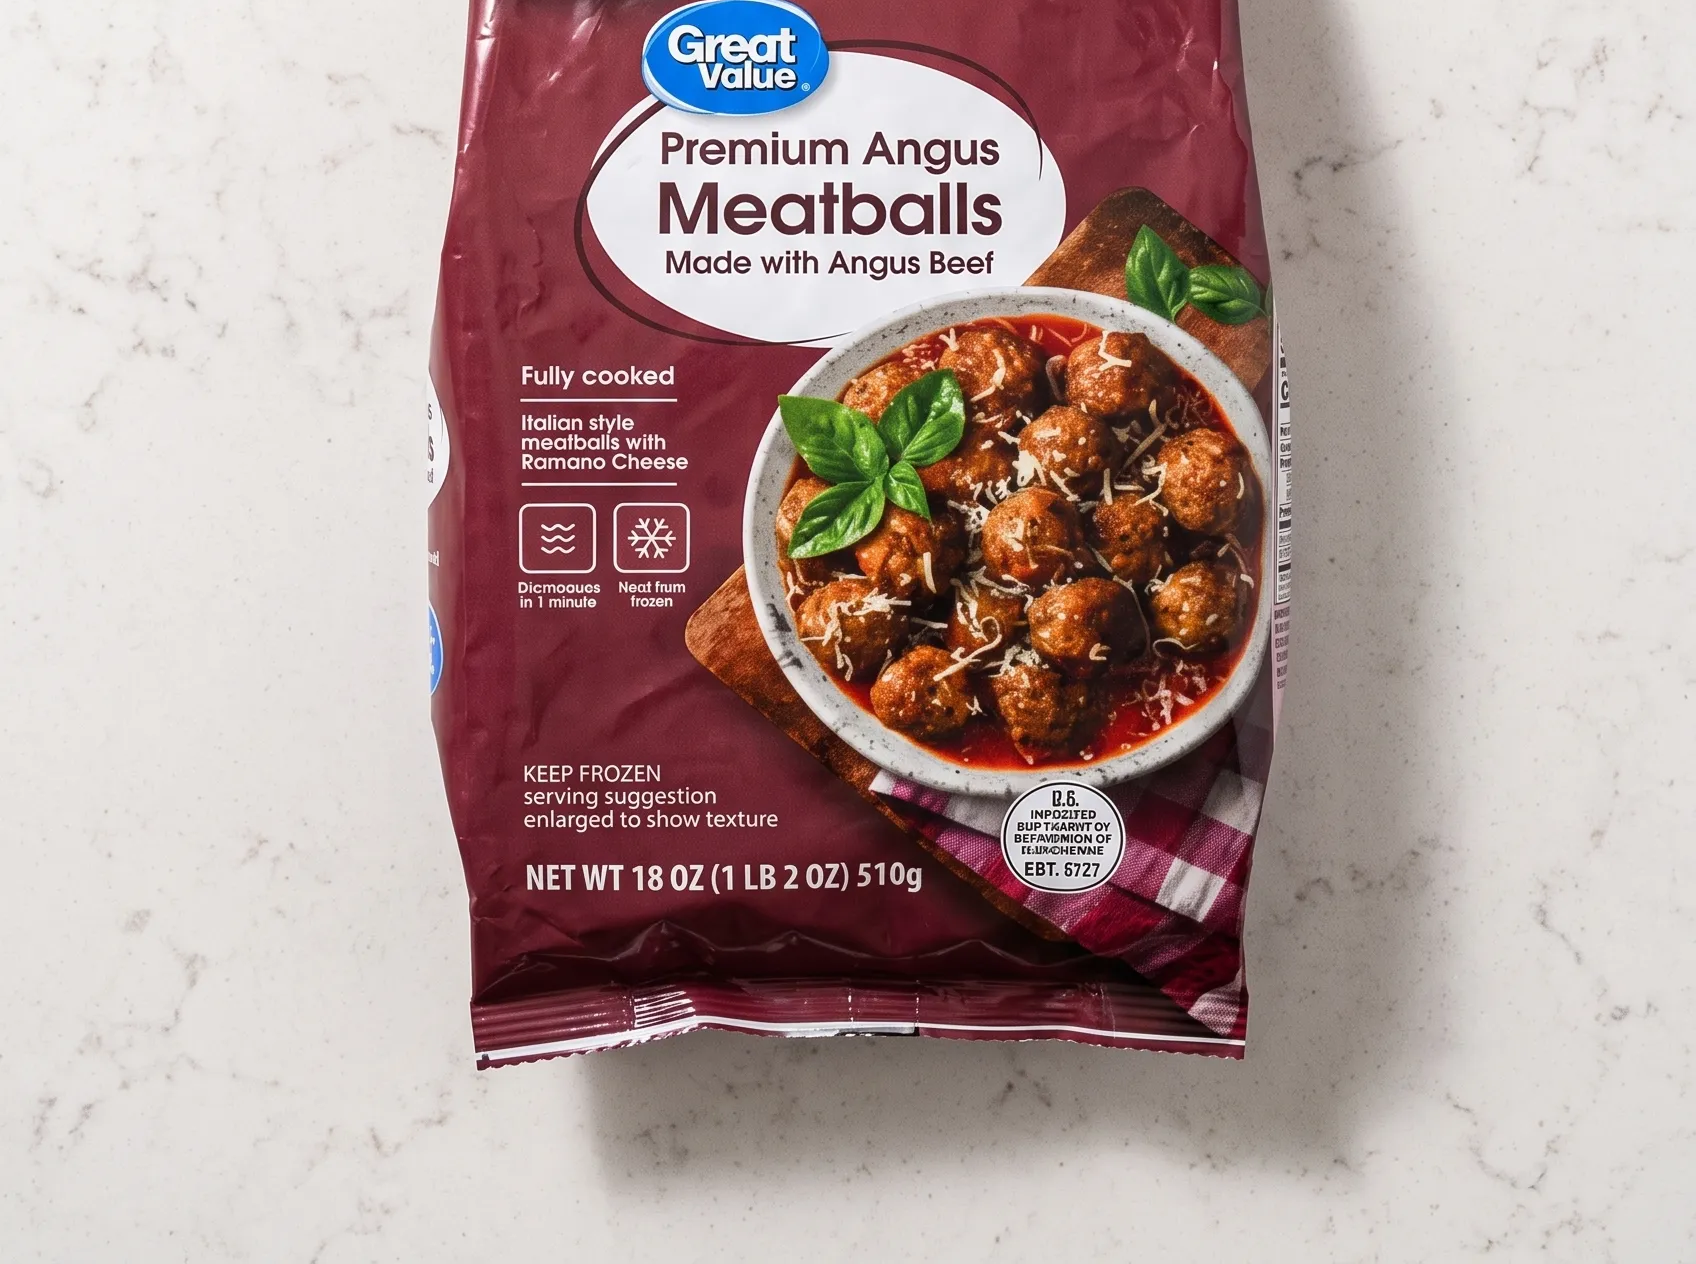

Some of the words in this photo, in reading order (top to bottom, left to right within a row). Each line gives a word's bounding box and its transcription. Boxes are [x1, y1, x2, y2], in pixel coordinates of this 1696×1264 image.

[667, 24, 797, 66] Great
[698, 62, 798, 92] Value
[660, 131, 850, 168] Premium
[861, 131, 1001, 178] Angus
[657, 181, 1003, 238] Meatballs
[664, 249, 752, 277] Made
[758, 249, 820, 277] with
[826, 249, 922, 283] Angus
[928, 248, 995, 277] Beef
[520, 365, 575, 390] Fully
[582, 365, 675, 386] cooked
[521, 413, 583, 433] Italian
[588, 413, 635, 437] style
[520, 433, 621, 452] meatballs
[626, 433, 667, 452] with
[520, 452, 606, 472] Ramano
[611, 452, 689, 472] Cheese
[618, 581, 652, 594] Neat
[655, 581, 686, 594] frum
[519, 596, 533, 608] in
[538, 596, 544, 608] 1
[630, 595, 673, 608] frozen
[523, 765, 574, 782] KEEP
[580, 764, 662, 782] FROZEN
[523, 786, 599, 811] serving
[604, 786, 718, 811] suggestion
[523, 809, 615, 834] enlarged
[620, 811, 641, 829] to
[646, 809, 702, 829] show
[706, 809, 779, 829] texture
[1095, 834, 1112, 843] OF
[525, 863, 575, 892] NET
[581, 863, 624, 892] WT
[631, 863, 663, 892] 18
[669, 863, 704, 892] OZ
[709, 863, 734, 895] (1
[744, 863, 777, 891] LB
[783, 863, 799, 890] 2
[805, 862, 849, 892] OZ)
[856, 861, 922, 893] 510g
[1024, 862, 1060, 877] EBT.
[1064, 862, 1101, 877] 6727
